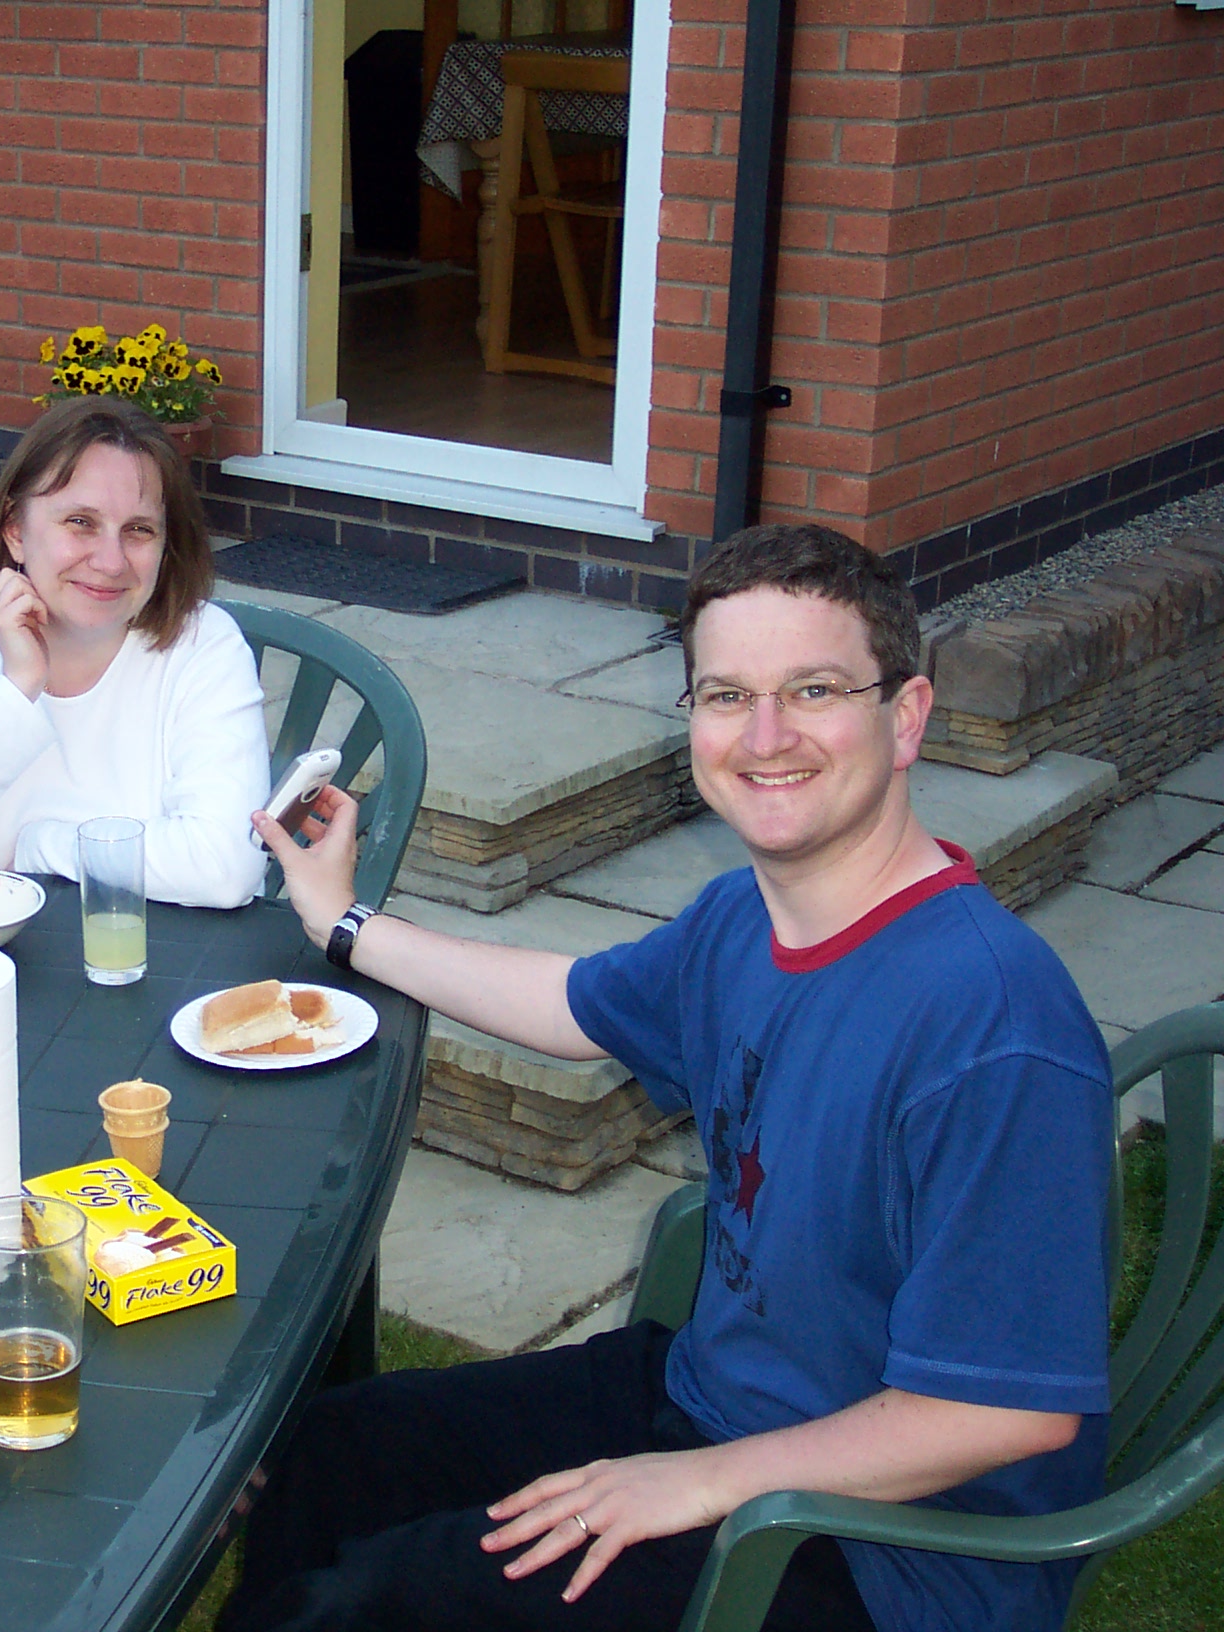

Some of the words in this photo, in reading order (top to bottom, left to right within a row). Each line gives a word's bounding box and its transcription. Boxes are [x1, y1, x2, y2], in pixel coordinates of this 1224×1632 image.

[66, 1186, 118, 1207] 99
[82, 1167, 161, 1214] Flake
[87, 1268, 111, 1309] 99
[126, 1280, 184, 1309] Flake
[186, 1263, 224, 1296] 99
